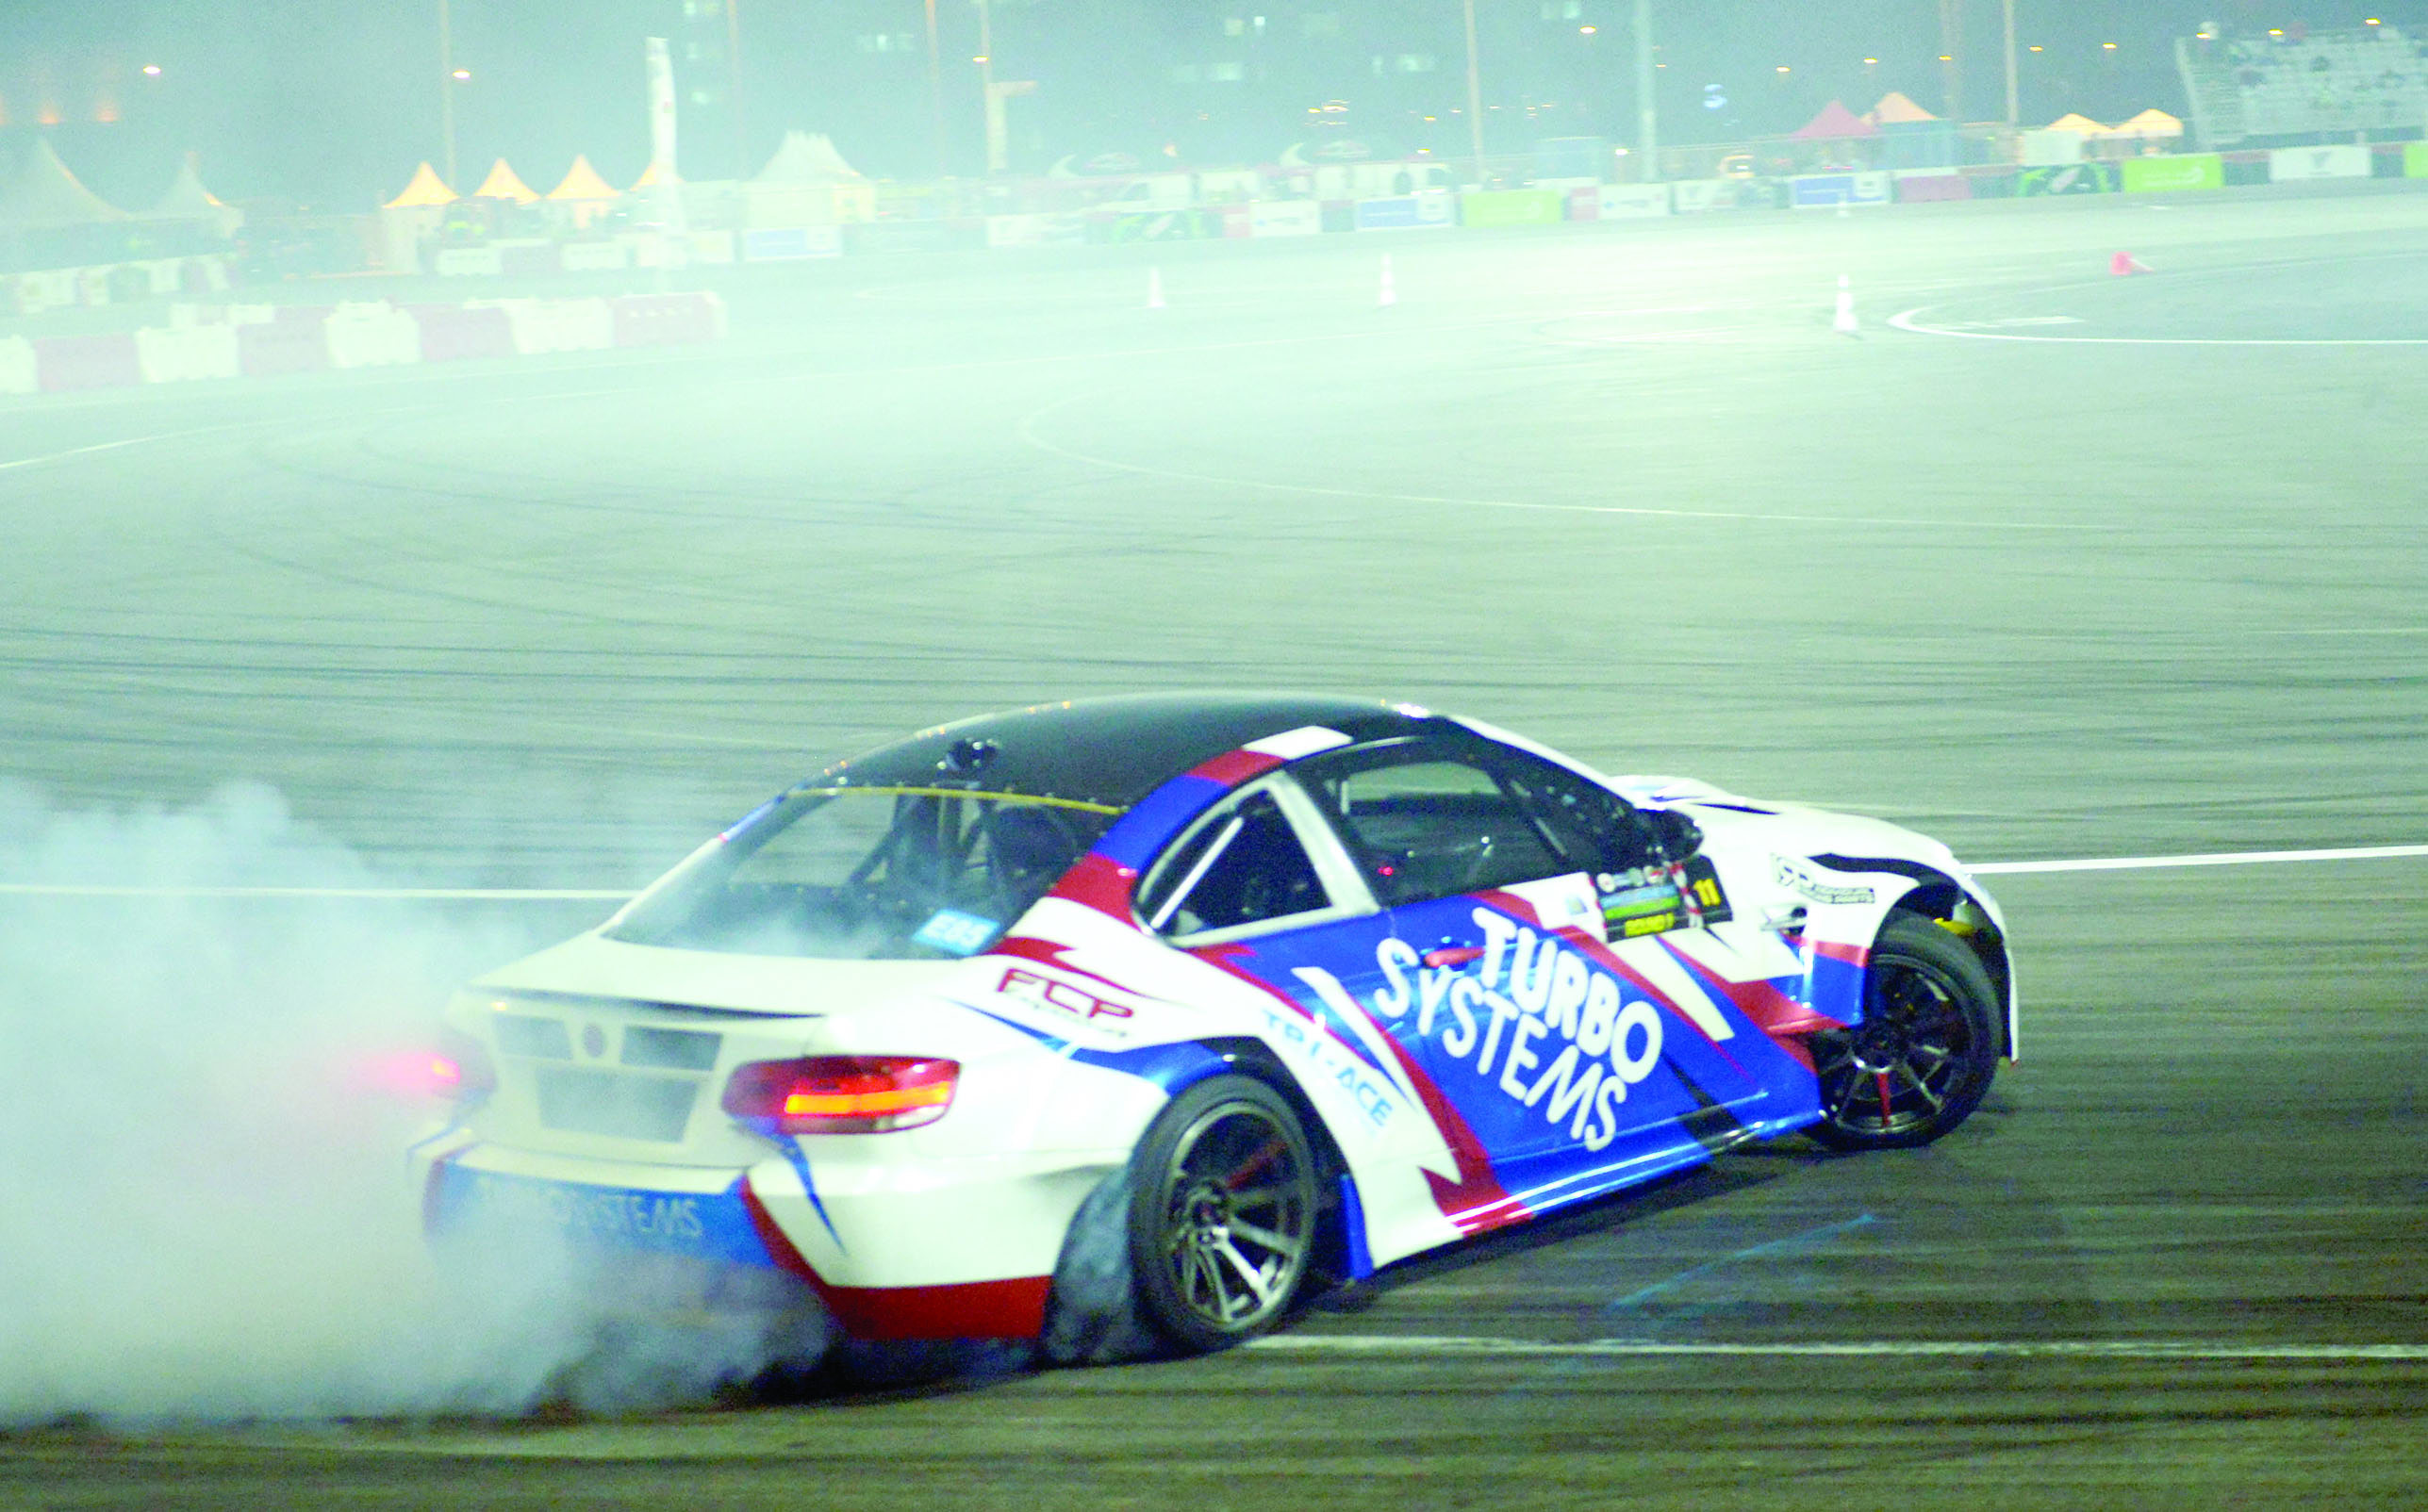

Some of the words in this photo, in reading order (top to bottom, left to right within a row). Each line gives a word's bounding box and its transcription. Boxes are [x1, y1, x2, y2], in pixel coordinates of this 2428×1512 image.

[1693, 878, 1722, 908] 11
[995, 966, 1134, 1019] FCP
[1374, 938, 1627, 1152] SYSTEMS
[1472, 907, 1663, 1084] TURBO
